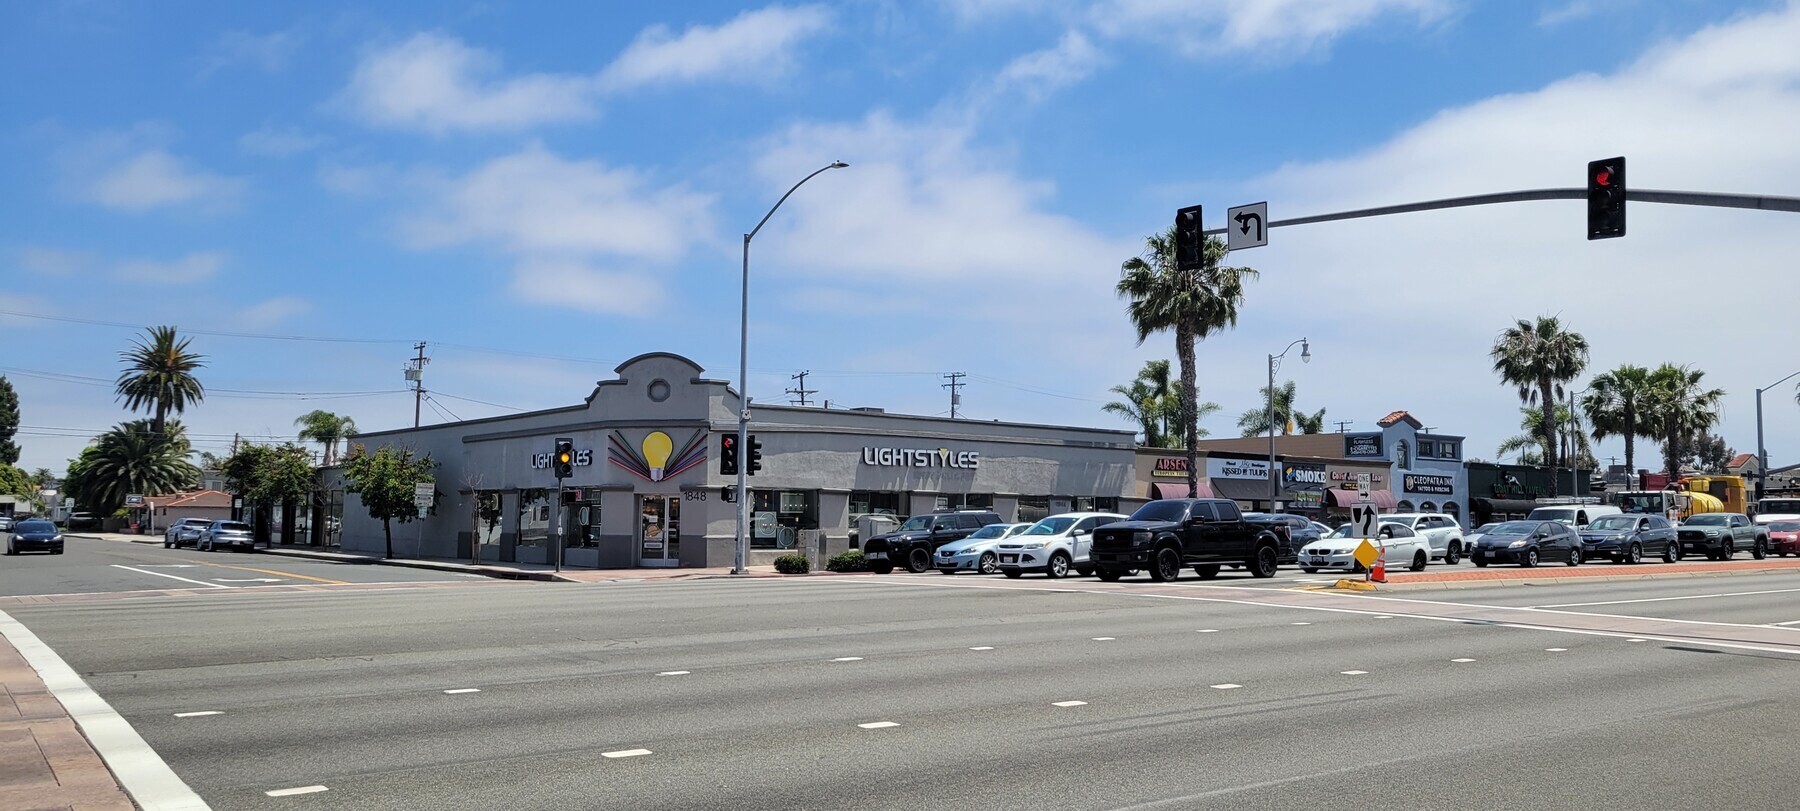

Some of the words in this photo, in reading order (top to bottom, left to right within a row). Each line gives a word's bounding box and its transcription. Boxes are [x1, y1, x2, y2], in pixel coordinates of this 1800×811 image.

[862, 447, 980, 469] LIGHTSTYLES
[1156, 458, 1188, 470] ARSEN
[1221, 467, 1242, 476] KISSED
[1249, 469, 1268, 477] TULIPS
[1295, 469, 1326, 483] SMOKE
[1359, 473, 1370, 482] ONE
[1413, 476, 1444, 485] CLEOPATRA
[683, 491, 707, 502] 1848
